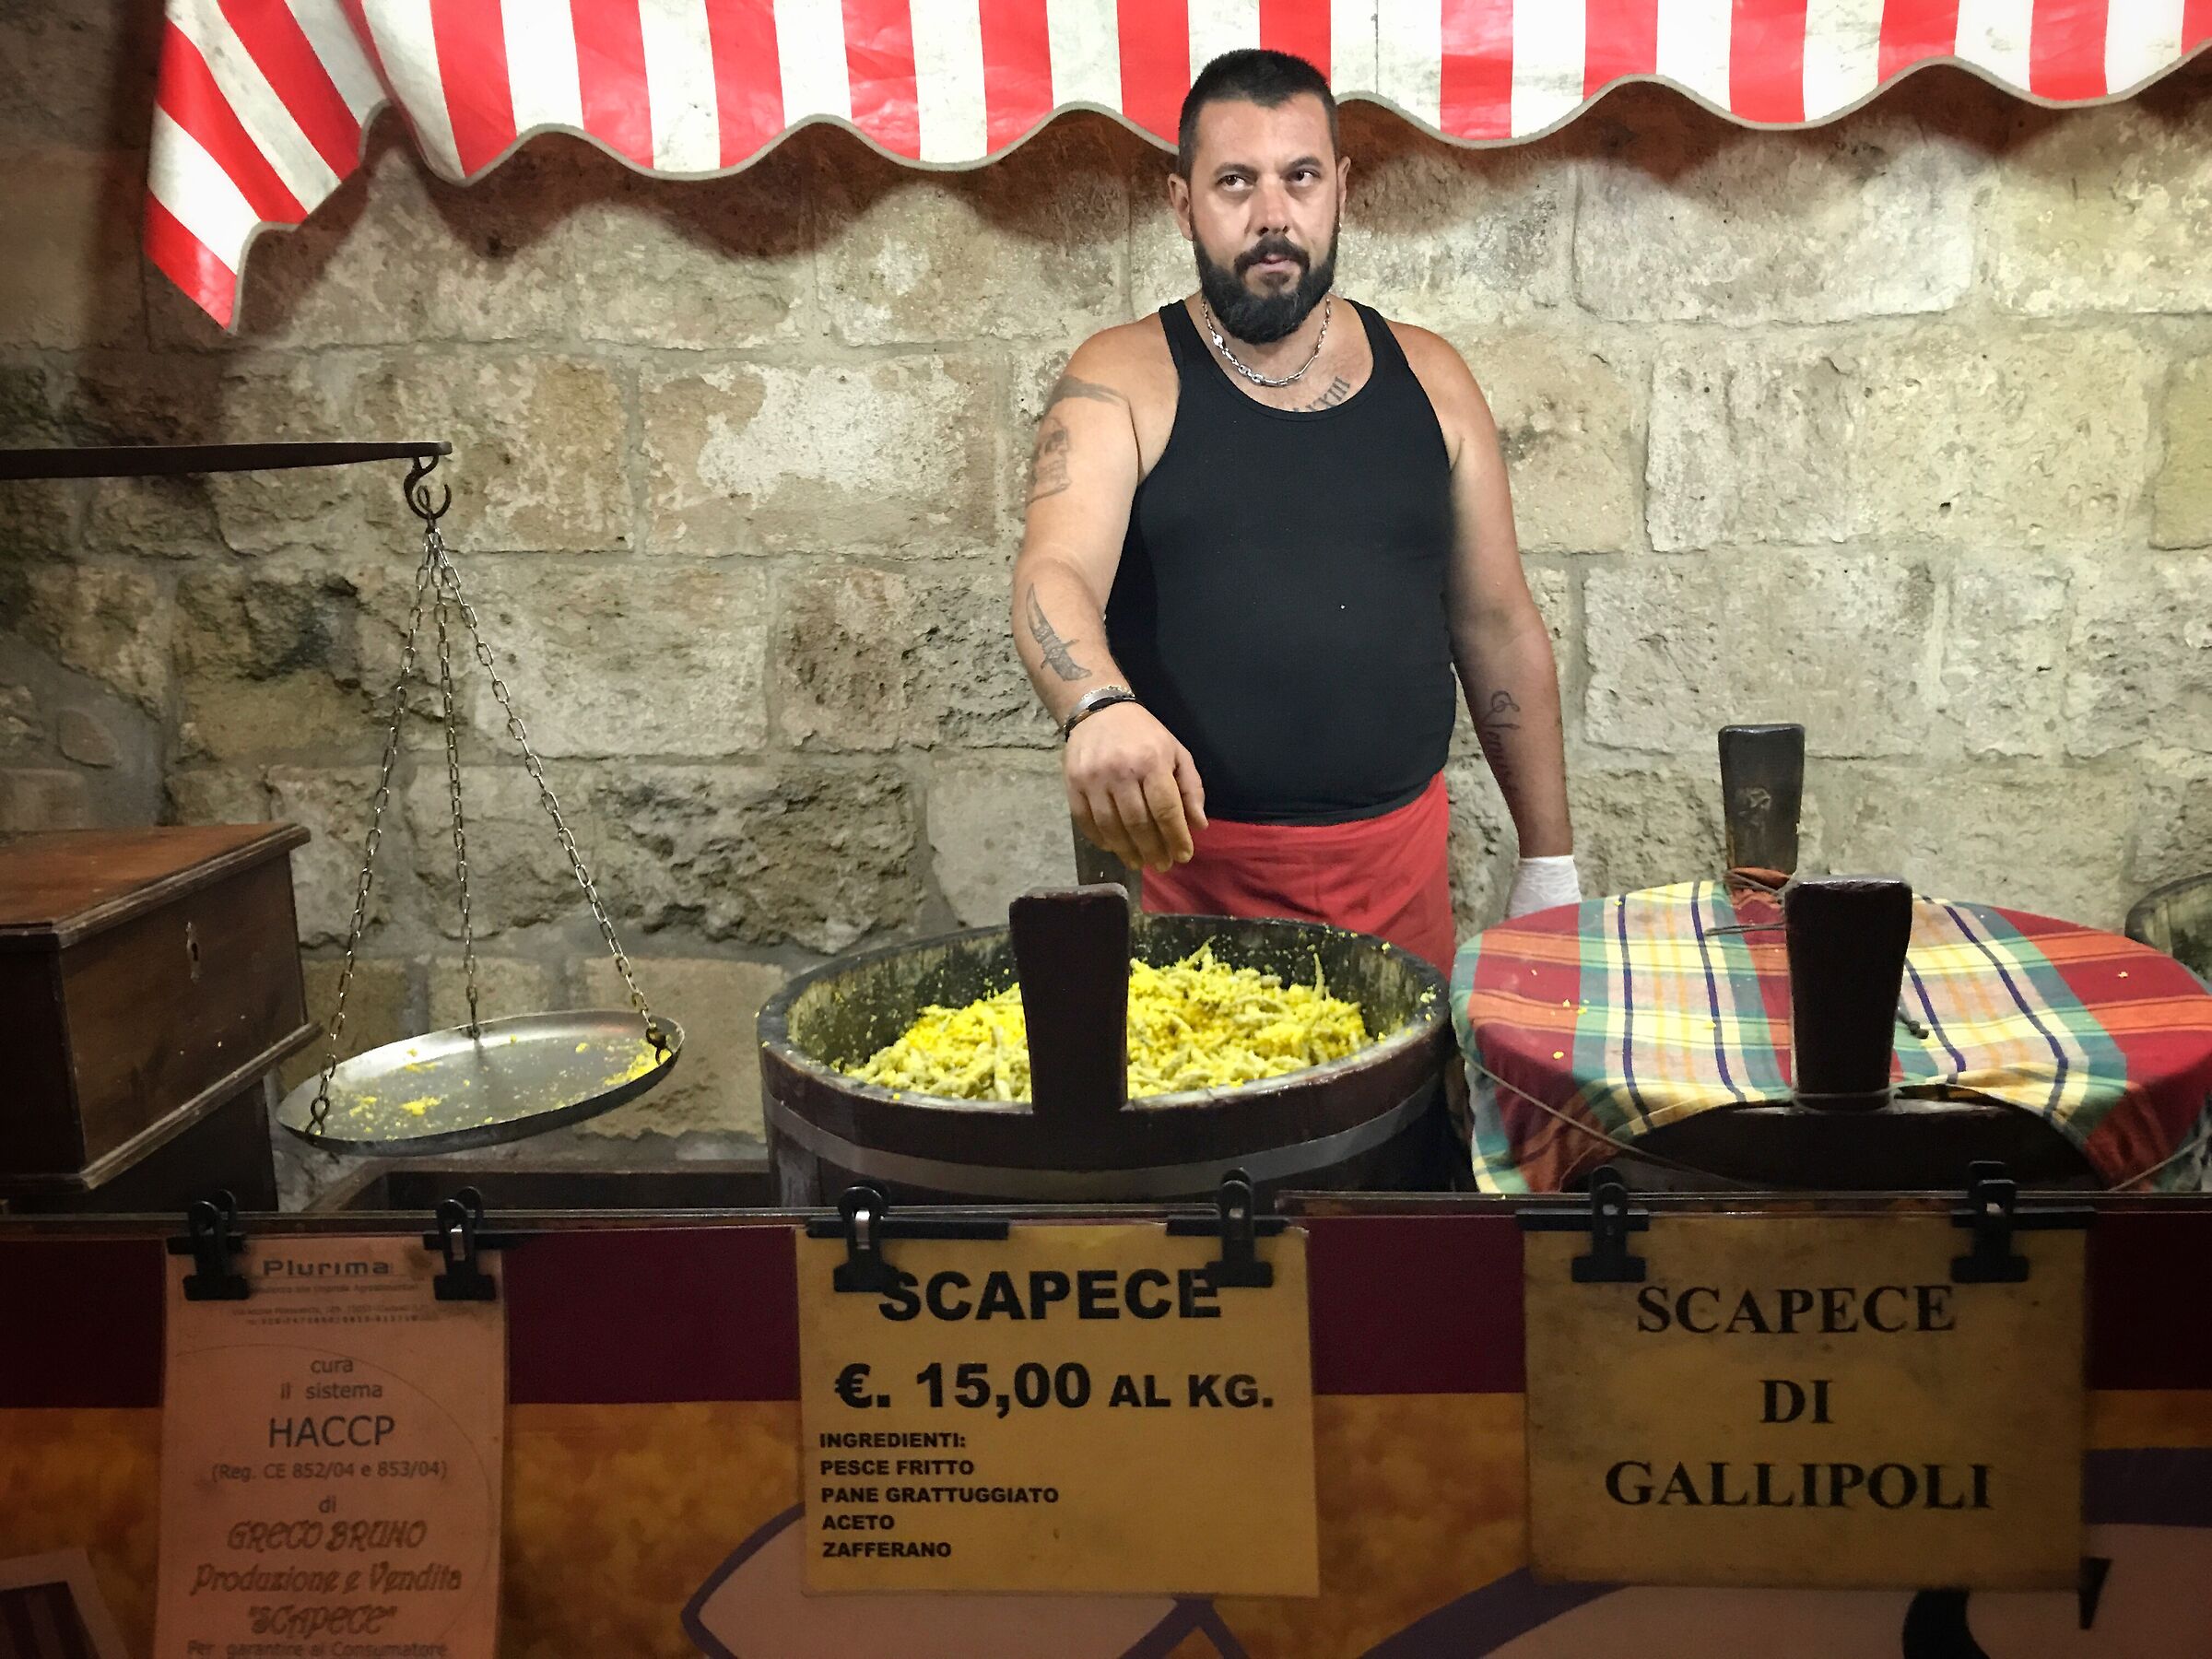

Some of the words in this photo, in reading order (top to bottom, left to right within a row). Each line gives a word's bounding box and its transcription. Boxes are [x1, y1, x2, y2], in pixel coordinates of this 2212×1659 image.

[263, 1260, 391, 1277] Plurima
[878, 1268, 1221, 1321] SCAPECE
[1637, 1285, 1956, 1334] SCAPECE
[311, 1358, 353, 1374] cura
[280, 1382, 290, 1399] il
[306, 1382, 382, 1399] sistema
[834, 1363, 890, 1408] €.
[915, 1362, 1091, 1418] 15,00
[1109, 1374, 1171, 1408] AL
[1188, 1374, 1275, 1408] KG.
[1759, 1379, 1833, 1424] DI
[269, 1416, 395, 1448] HACCP
[819, 1432, 967, 1449] INGREDIENTI:
[212, 1462, 256, 1482] (Reg.
[264, 1463, 286, 1478] CE
[293, 1462, 354, 1478] 852/04
[360, 1465, 371, 1477] e
[378, 1461, 447, 1480] 853/04)
[820, 1460, 890, 1477] PESCE
[896, 1460, 975, 1477] FRITTO
[1606, 1460, 1994, 1510] GALLIPOLI
[318, 1496, 337, 1513] di
[821, 1488, 879, 1504] PANE
[886, 1487, 1060, 1504] GRATTUGGIATO
[822, 1514, 896, 1531] ACETO
[822, 1541, 953, 1559] ZAFFERANO
[190, 1564, 340, 1595] Produzione
[342, 1572, 359, 1594] e
[370, 1561, 462, 1594] Vendita
